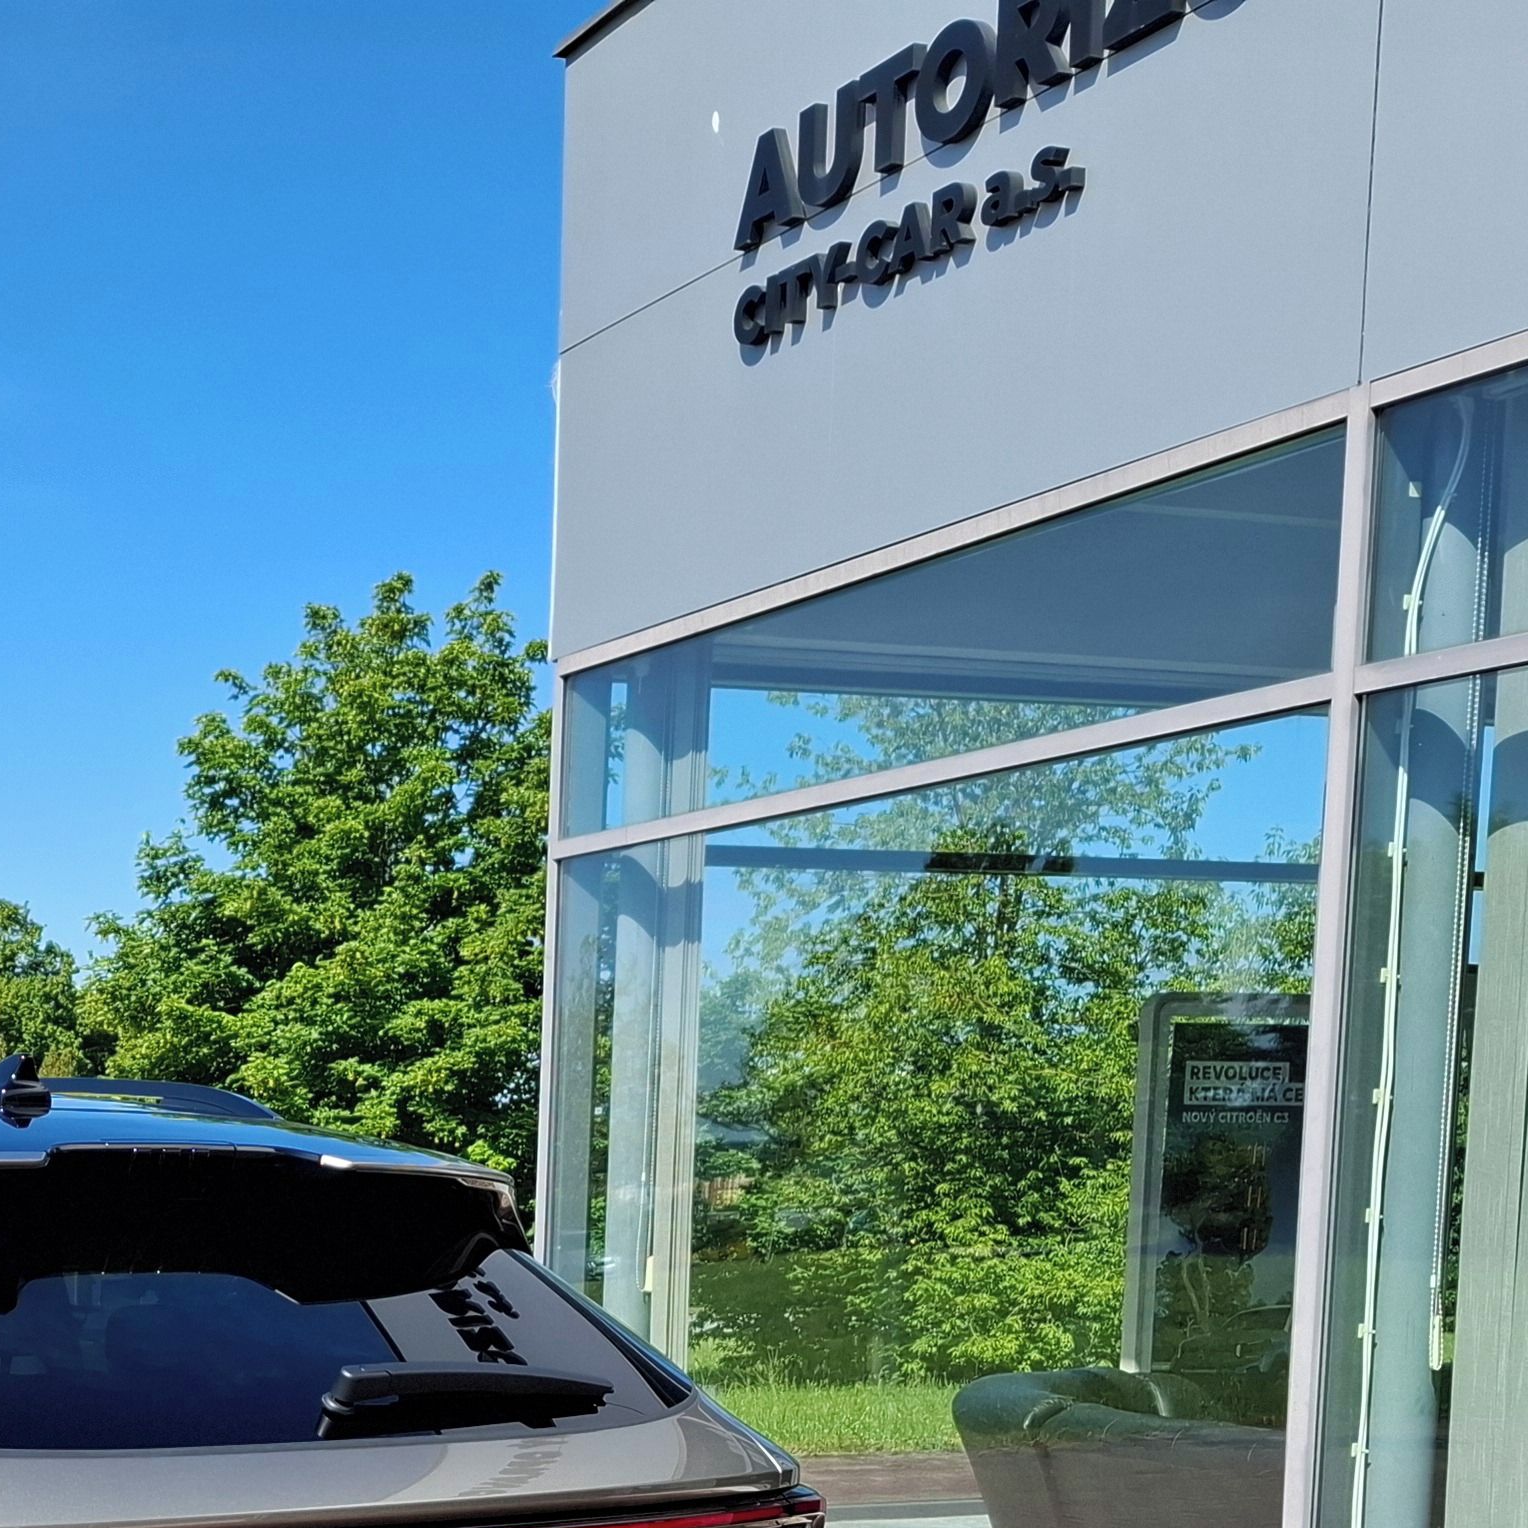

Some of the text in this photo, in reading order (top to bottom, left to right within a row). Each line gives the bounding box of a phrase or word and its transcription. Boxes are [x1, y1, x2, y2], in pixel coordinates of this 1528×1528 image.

[734, 146, 1086, 346] CITY-CAR a.s.
[1190, 1065, 1286, 1083] REVOLUCE,
[1182, 1109, 1289, 1123] NOVÝ CITROËN C3
